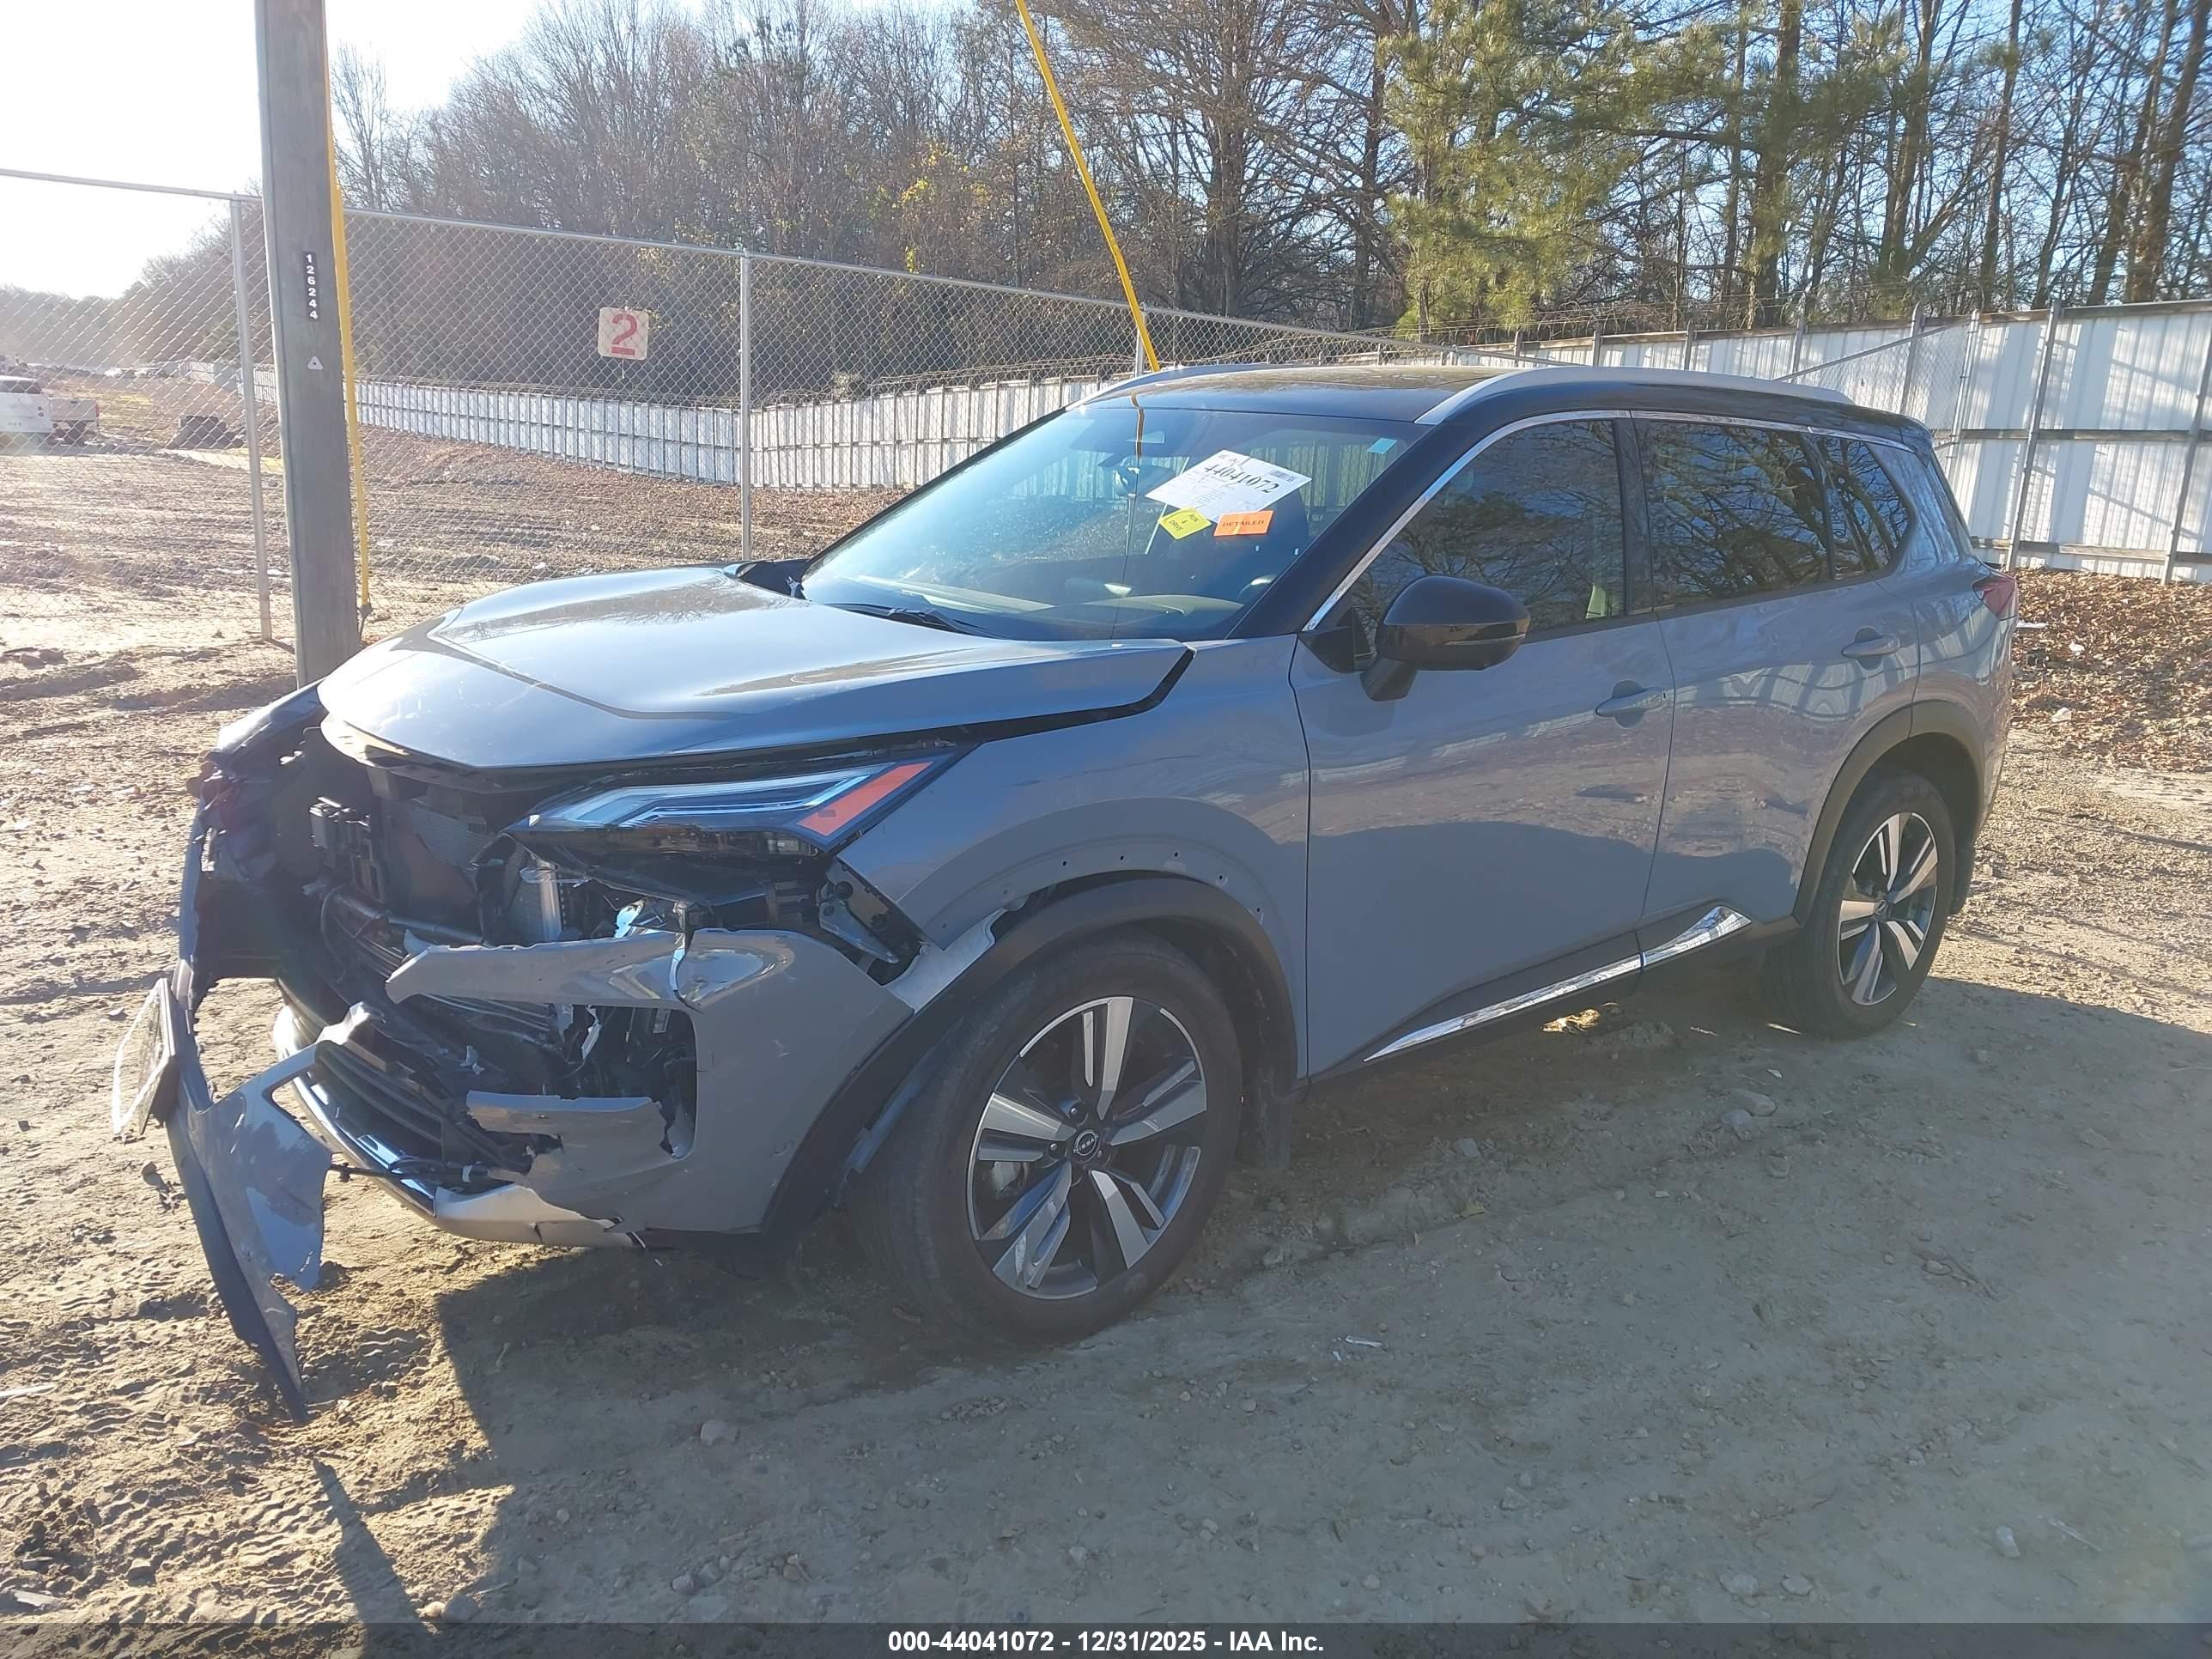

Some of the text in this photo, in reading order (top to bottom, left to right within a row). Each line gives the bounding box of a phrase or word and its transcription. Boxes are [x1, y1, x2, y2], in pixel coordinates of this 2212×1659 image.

[305, 253, 319, 319] 126244
[611, 313, 637, 357] 2
[1205, 464, 1279, 494] 44041072
